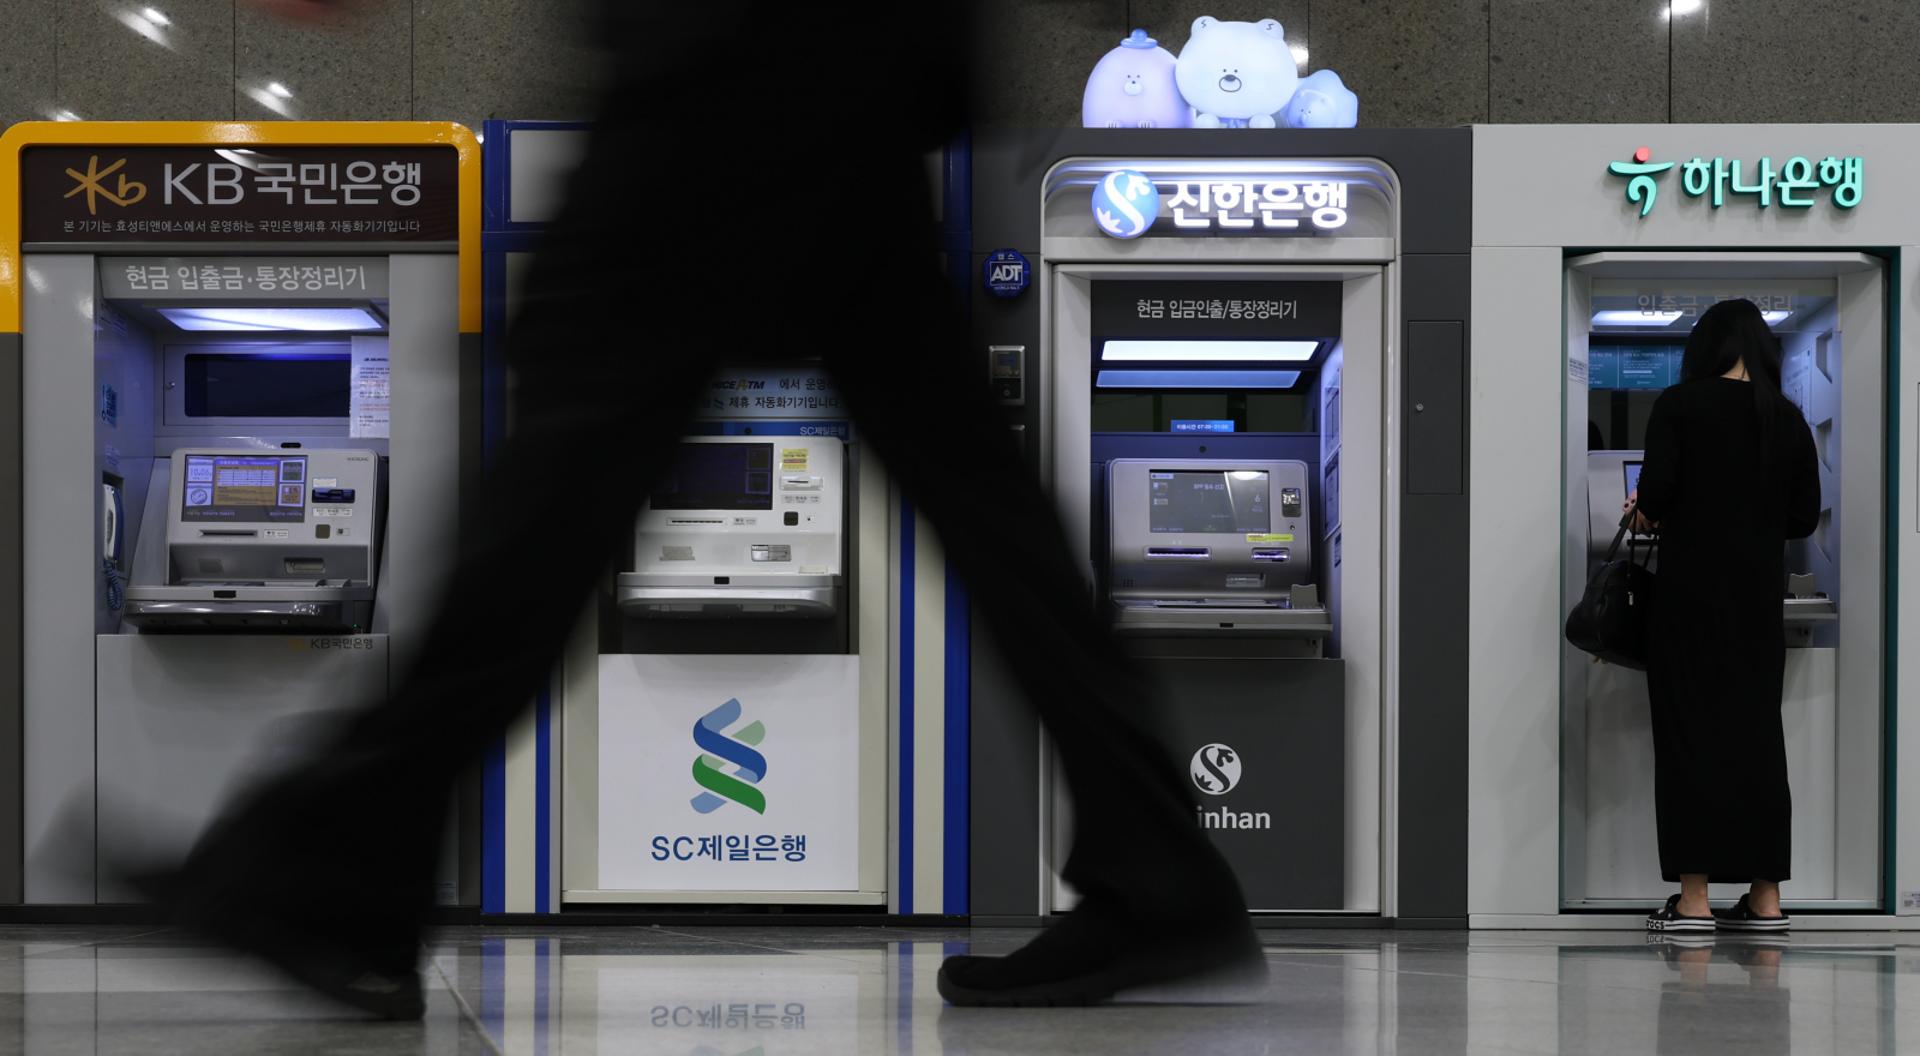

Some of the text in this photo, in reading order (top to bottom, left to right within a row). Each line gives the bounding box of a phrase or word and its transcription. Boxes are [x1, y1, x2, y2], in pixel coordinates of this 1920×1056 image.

[1681, 156, 1864, 209] 하나은행
[1167, 181, 1349, 229] 신한은행
[63, 220, 420, 233] 본 기기는 효성티앤에스에서 운영하는 국민은행제휴 자동화기기입니다
[126, 265, 170, 290] 현금
[991, 264, 1022, 281] ADT
[1137, 299, 1297, 319] 현금 입금인출/통장정리기
[779, 378, 800, 390] 에서
[729, 396, 750, 409] 제휴
[1197, 805, 1271, 829] inhan
[651, 834, 806, 862] SC제일은행
